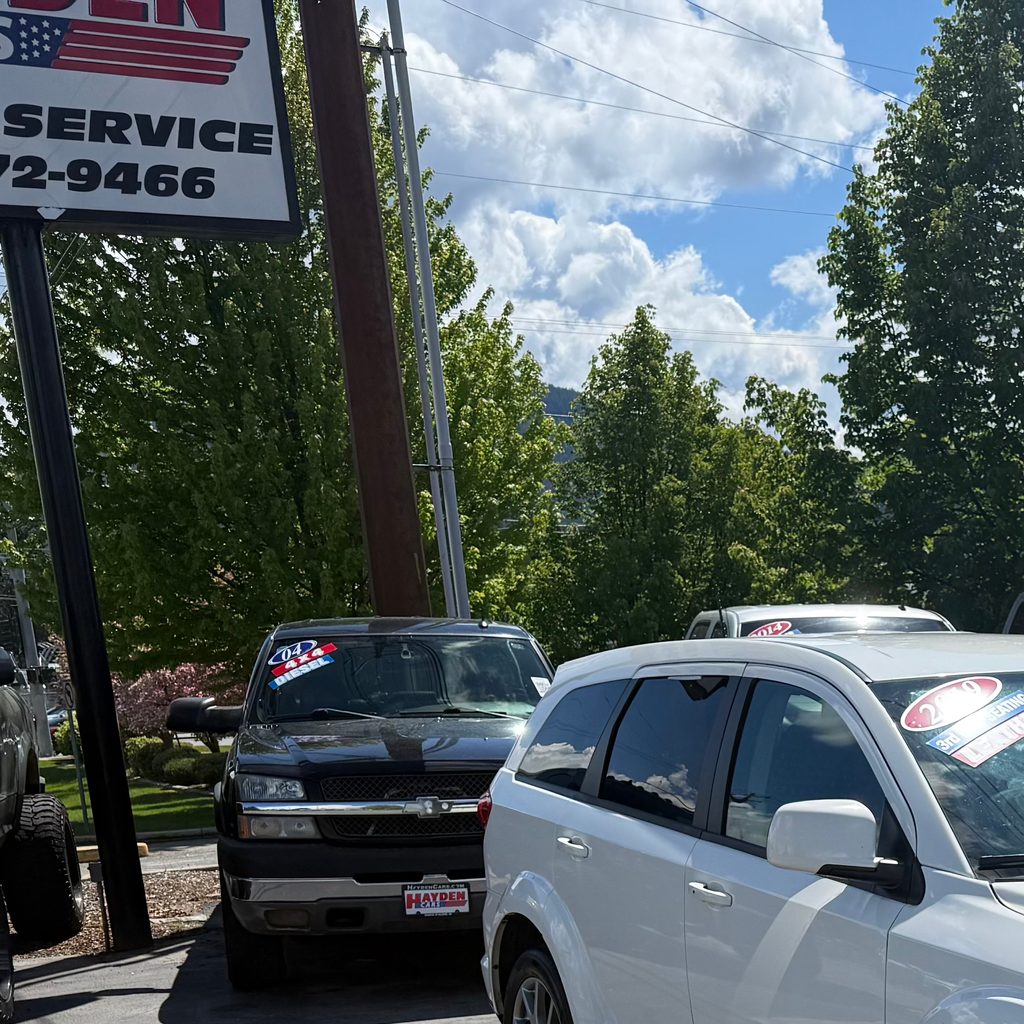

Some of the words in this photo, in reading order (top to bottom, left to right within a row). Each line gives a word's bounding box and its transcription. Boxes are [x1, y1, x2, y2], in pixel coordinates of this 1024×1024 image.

[3, 103, 274, 156] SERVICE
[281, 643, 302, 661] 04
[274, 656, 330, 687] DIESEL
[918, 680, 982, 725] 29
[935, 730, 961, 751] 3rd
[406, 891, 466, 910] HAYDEN
[420, 901, 441, 909] CARS
